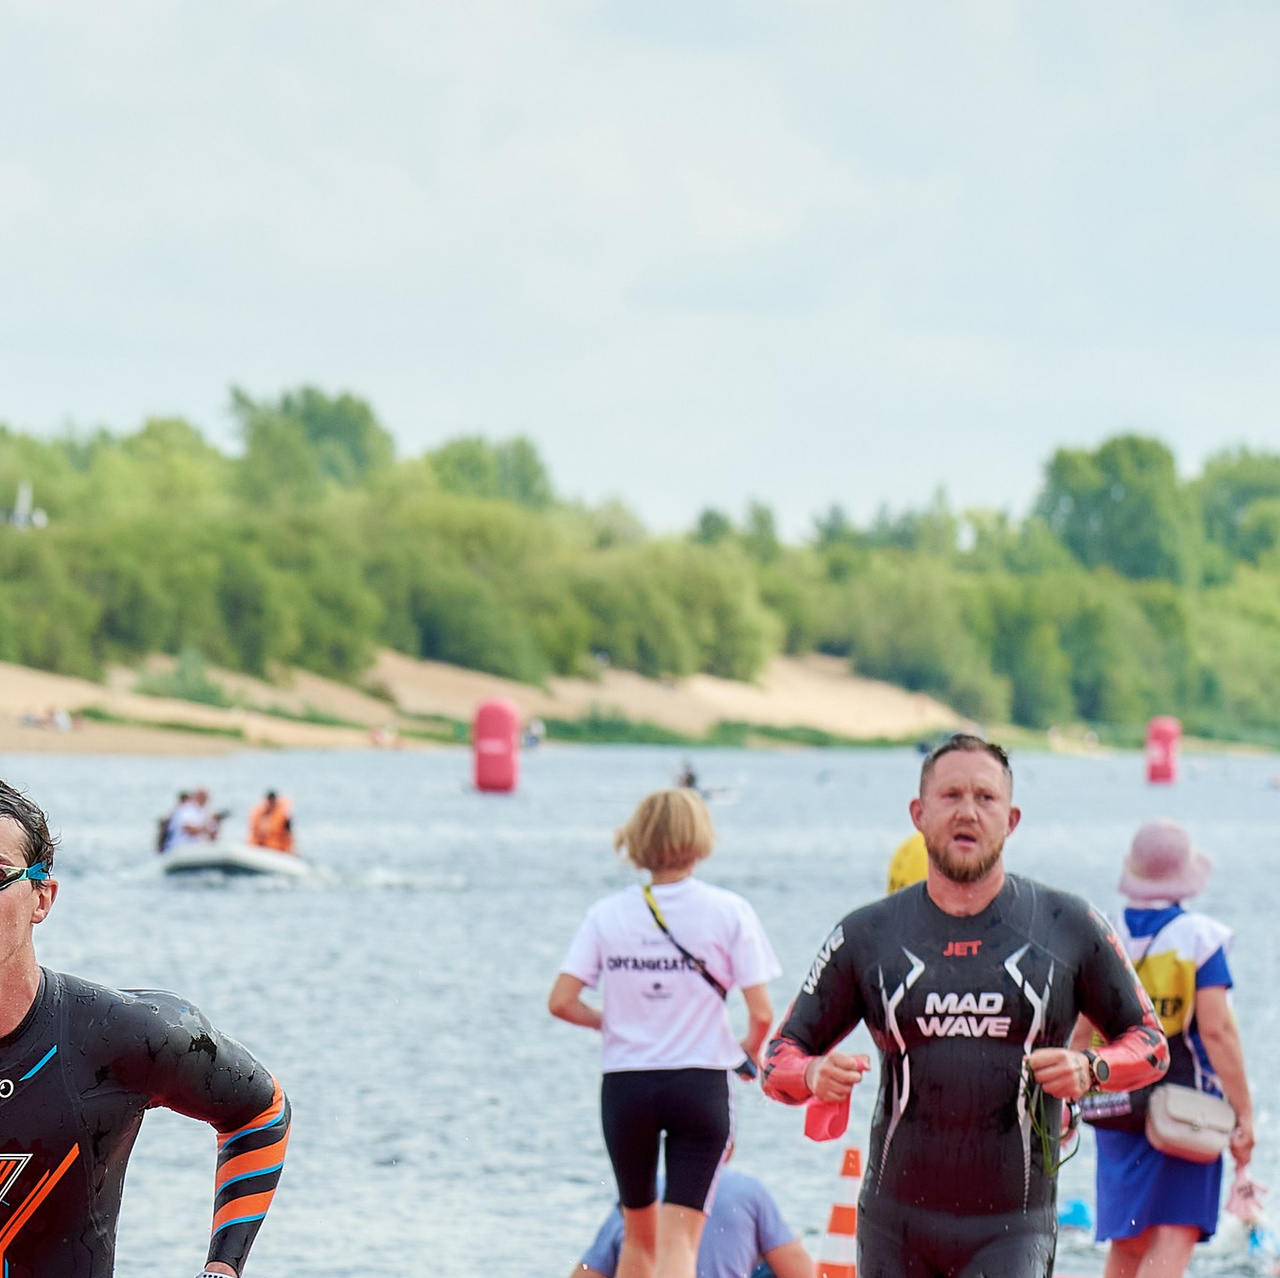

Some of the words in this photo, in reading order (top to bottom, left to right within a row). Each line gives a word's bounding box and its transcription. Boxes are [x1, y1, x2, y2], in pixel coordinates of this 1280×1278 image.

[943, 940, 982, 956] JET
[802, 924, 845, 995] WAVE
[925, 992, 1004, 1014] MAD
[916, 1017, 1011, 1037] WAVE
